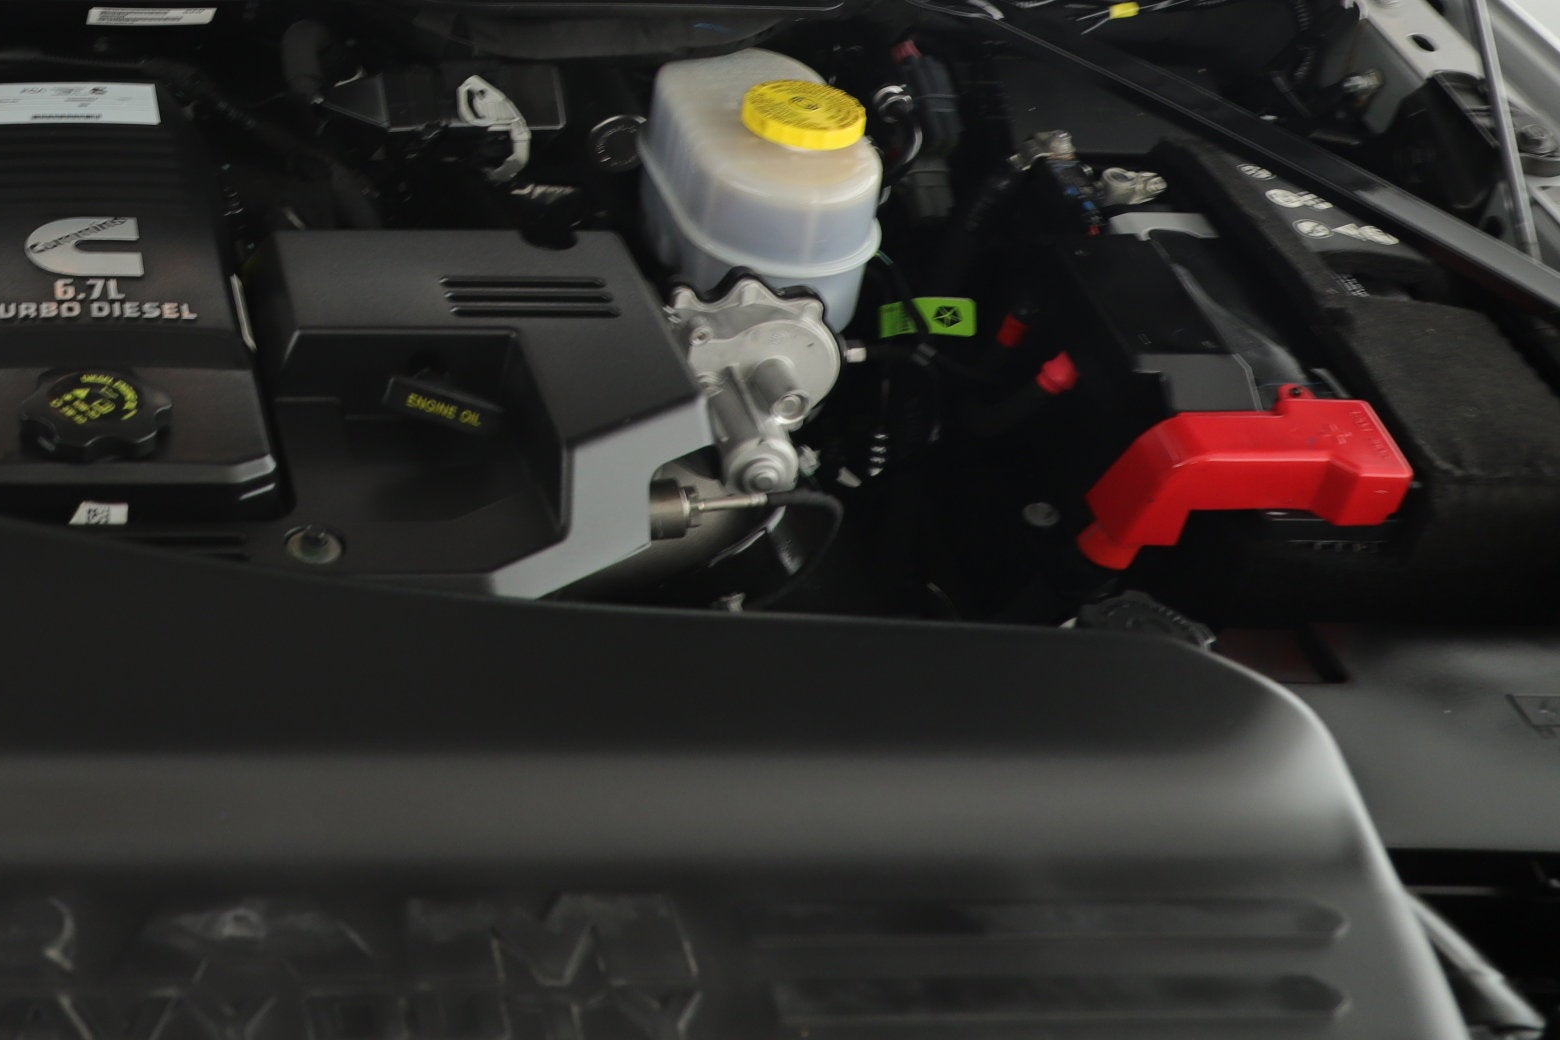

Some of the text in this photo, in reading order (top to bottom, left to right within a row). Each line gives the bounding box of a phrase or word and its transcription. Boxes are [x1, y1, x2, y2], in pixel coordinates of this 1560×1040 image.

[28, 216, 129, 254] Cummins
[53, 277, 126, 301] 6.7L
[89, 301, 198, 321] DIESEL
[406, 392, 482, 428] ENGINE OIL
